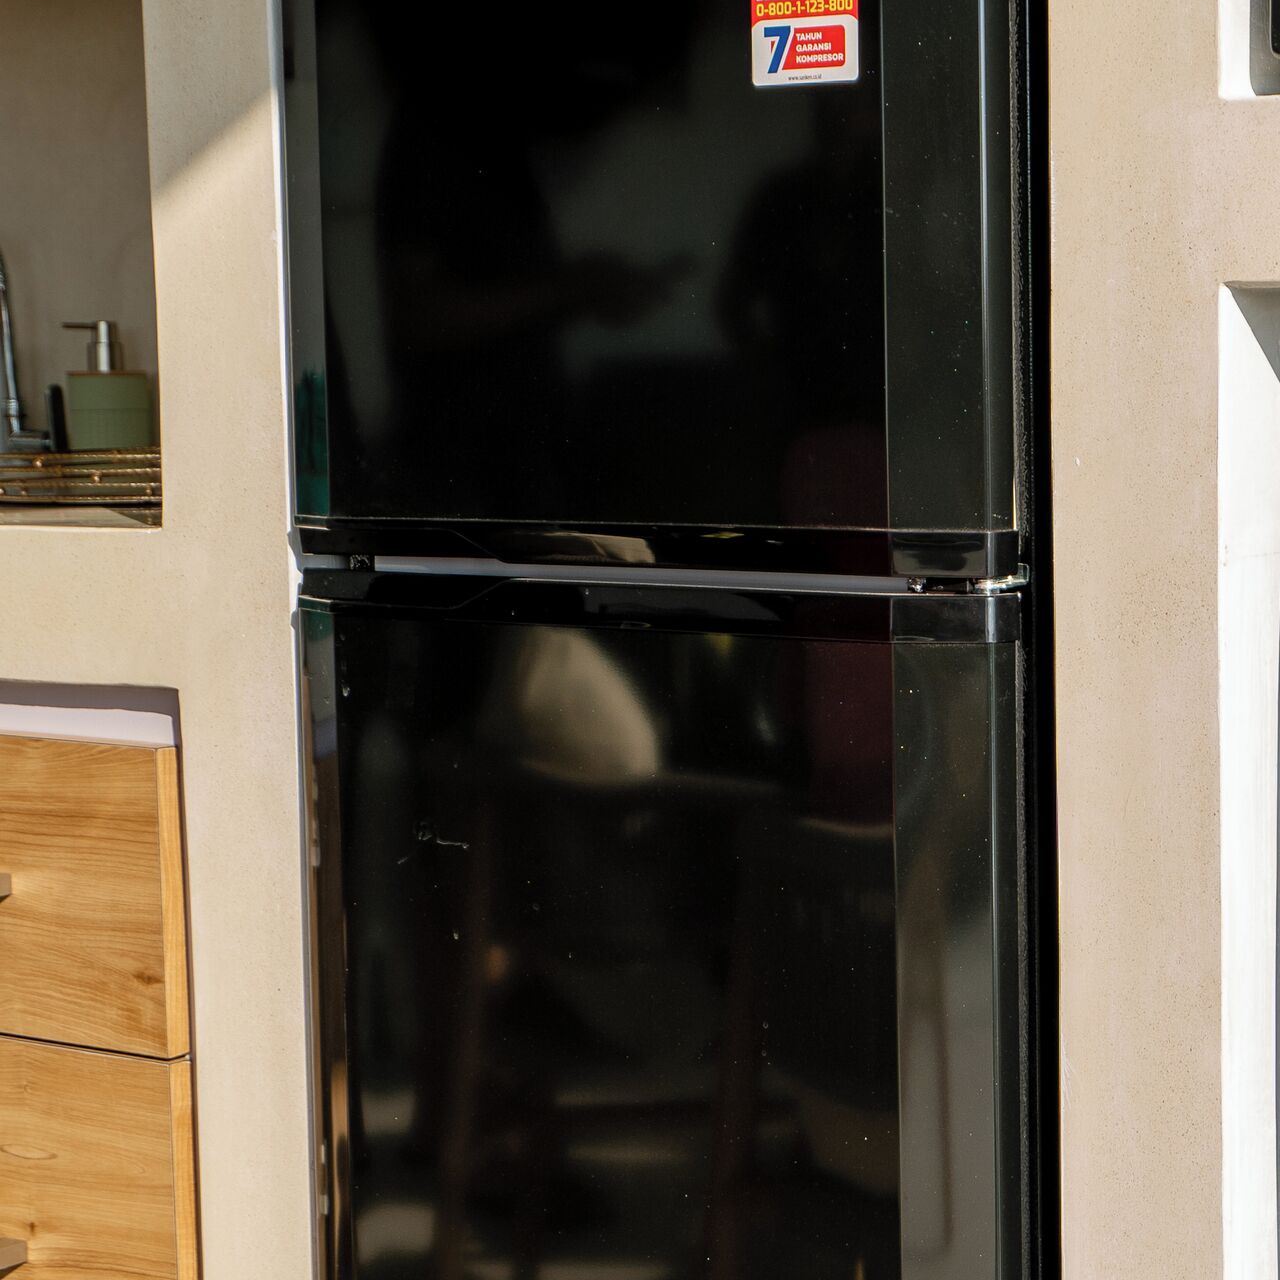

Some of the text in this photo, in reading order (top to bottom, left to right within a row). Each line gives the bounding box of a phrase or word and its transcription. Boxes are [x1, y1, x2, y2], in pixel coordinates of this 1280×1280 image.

[796, 31, 822, 41] TAHUN
[763, 25, 791, 74] 7
[796, 42, 831, 52] GARANSI
[796, 53, 844, 64] KOMPRESOR
